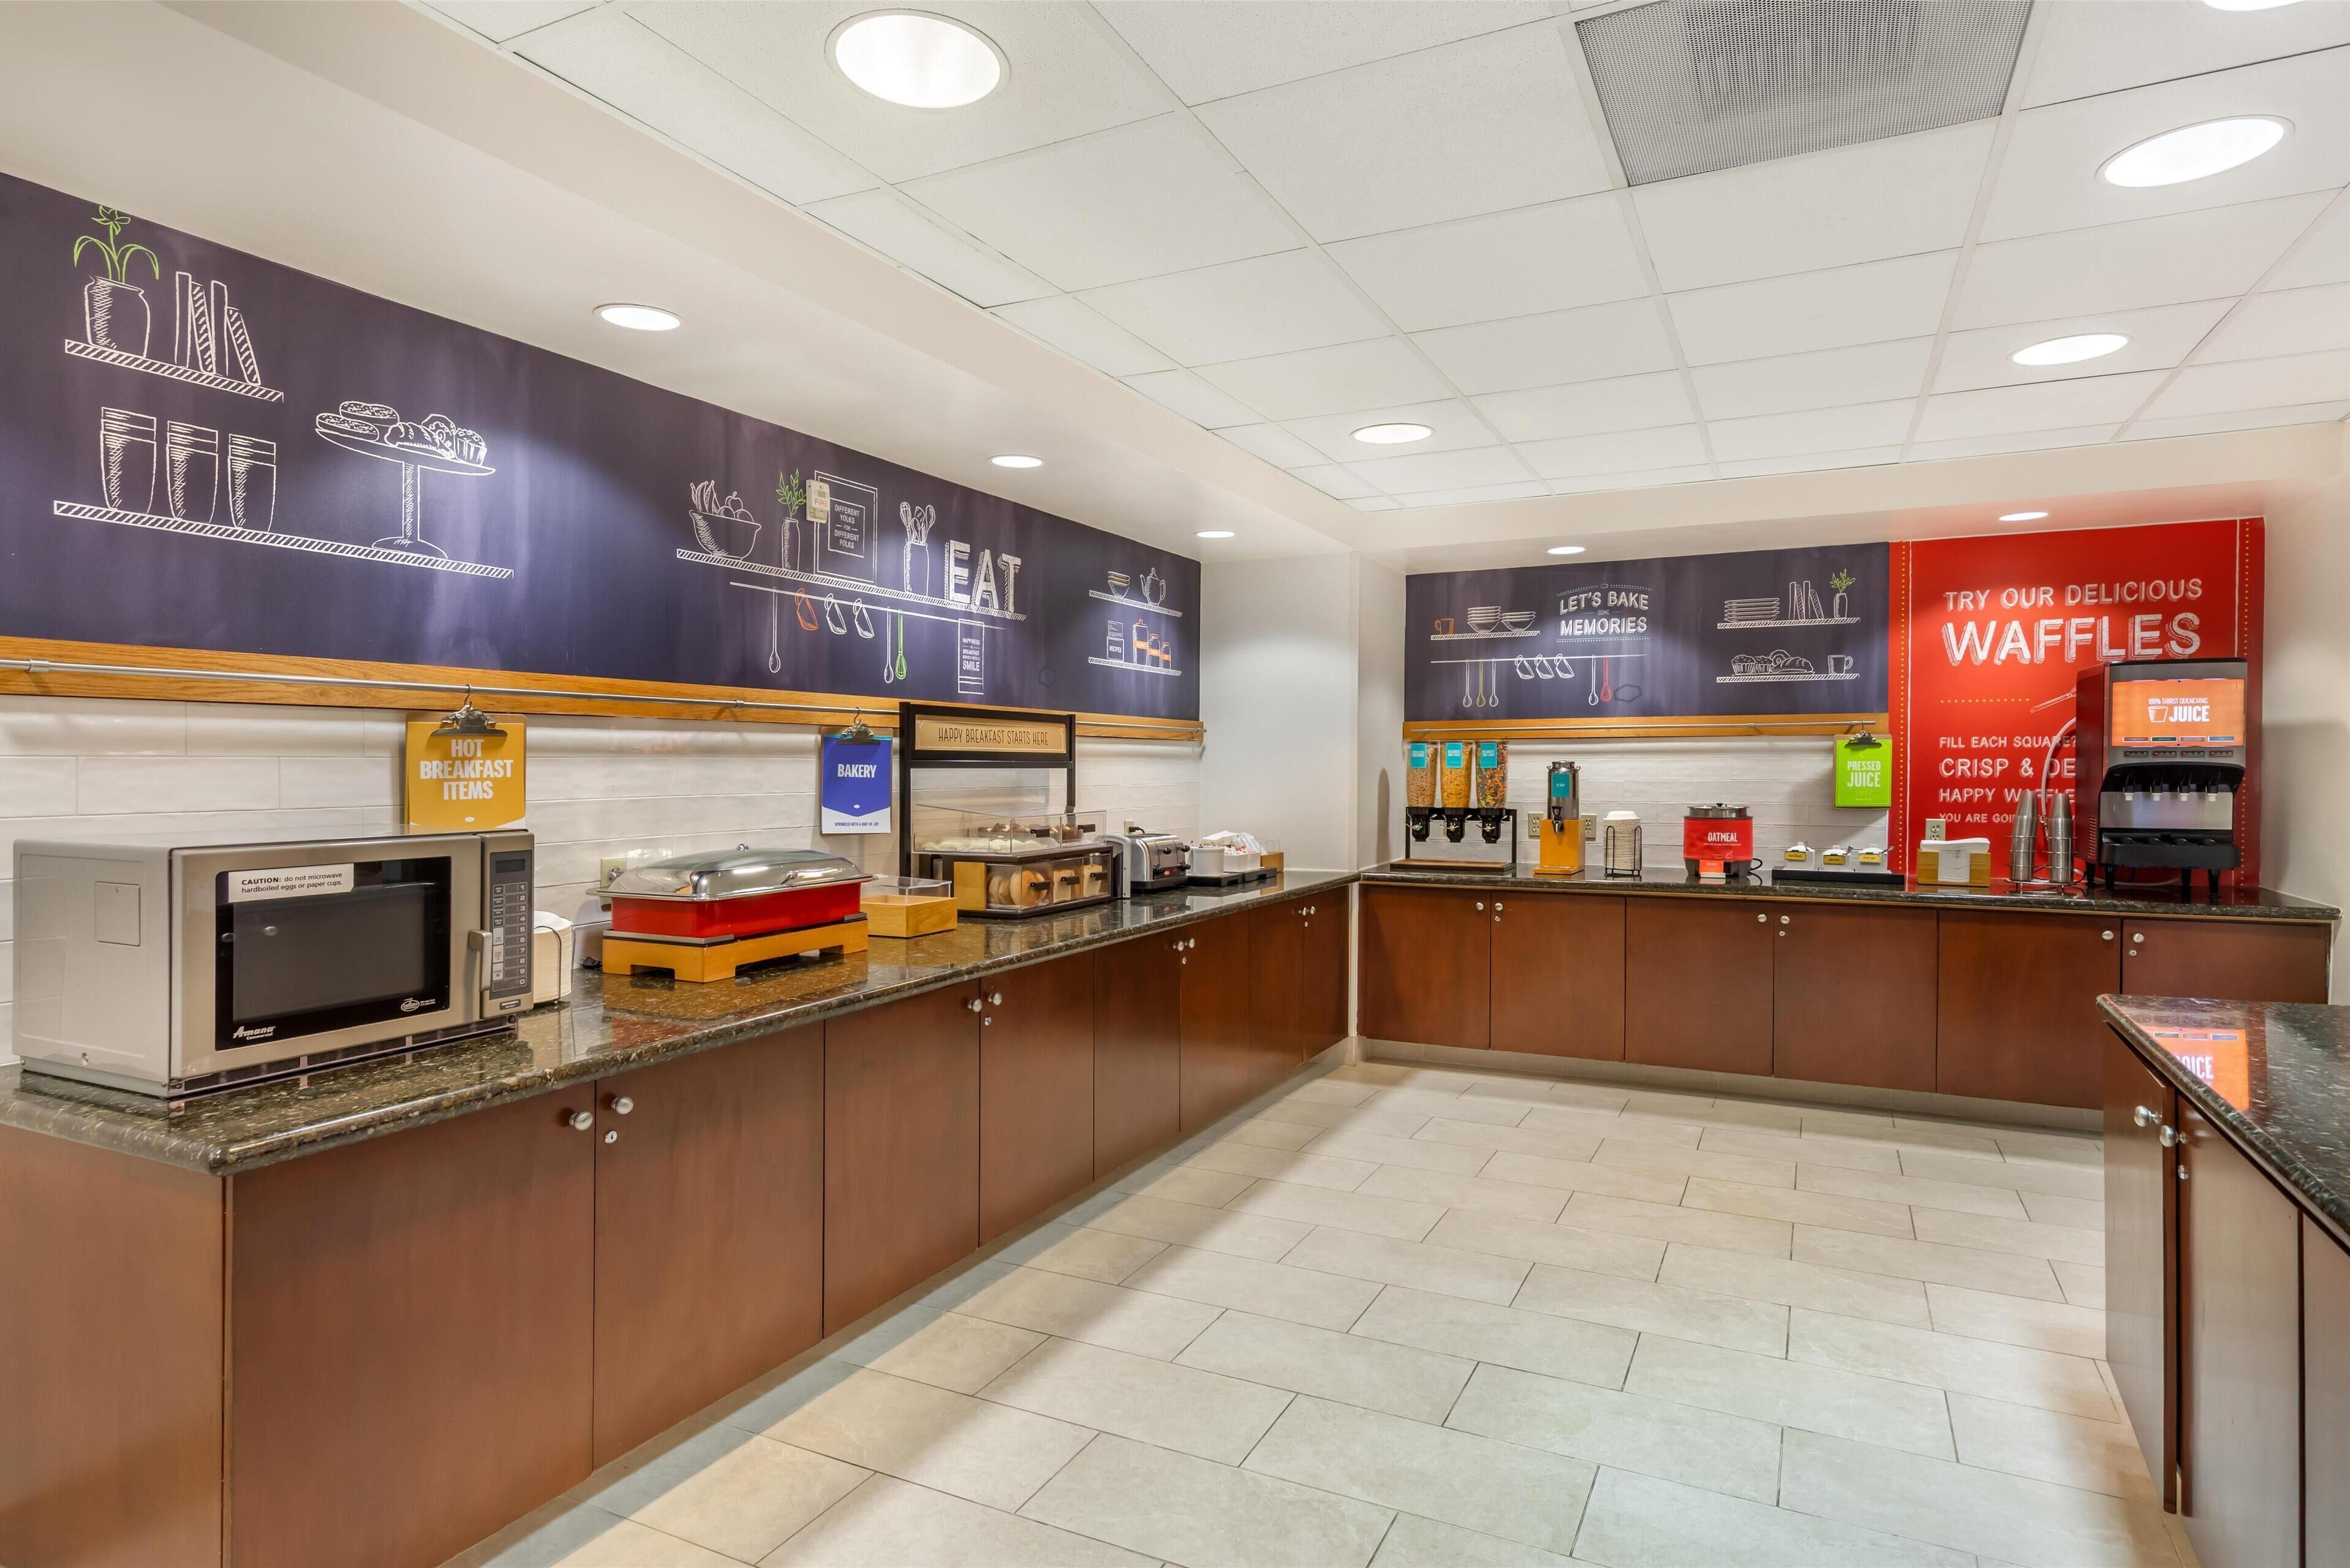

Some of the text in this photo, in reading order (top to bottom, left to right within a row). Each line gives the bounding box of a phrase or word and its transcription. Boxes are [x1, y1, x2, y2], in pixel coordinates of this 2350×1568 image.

[815, 499, 828, 507] FIRE
[835, 505, 860, 516] DIFFERENT
[840, 514, 855, 524] YOLKS
[834, 530, 859, 541] DIFFERENT
[839, 540, 855, 549] FOLKS
[945, 540, 1021, 612] EAT
[1944, 578, 2202, 612] TRY OUR DELICIOUS
[1560, 591, 1649, 615] LET'S BAKE
[1560, 617, 1647, 636] MEMORIES
[1941, 612, 2201, 667] WAFFLES
[962, 660, 980, 671] SMILE
[2169, 706, 2210, 722] JUICE
[939, 727, 1048, 745] HAPPY BREAKFAST STARTS HERE
[1940, 736, 1965, 748] FILL
[1971, 736, 2007, 748] EACH
[451, 739, 485, 758] HOT
[420, 760, 514, 780] BREAKFAST
[837, 764, 877, 778] BAKERY
[1847, 761, 1881, 771] PRESSED
[1939, 758, 2009, 778] CRISP
[2019, 758, 2035, 778] &
[1847, 772, 1881, 788] JUICE
[444, 780, 494, 801] ITEMS
[1939, 788, 1996, 803] HAPPY
[1940, 813, 1961, 823] YOU
[1965, 813, 1988, 823] ARE
[1707, 832, 1738, 842] OATMEAL
[233, 1026, 276, 1039] Amana
